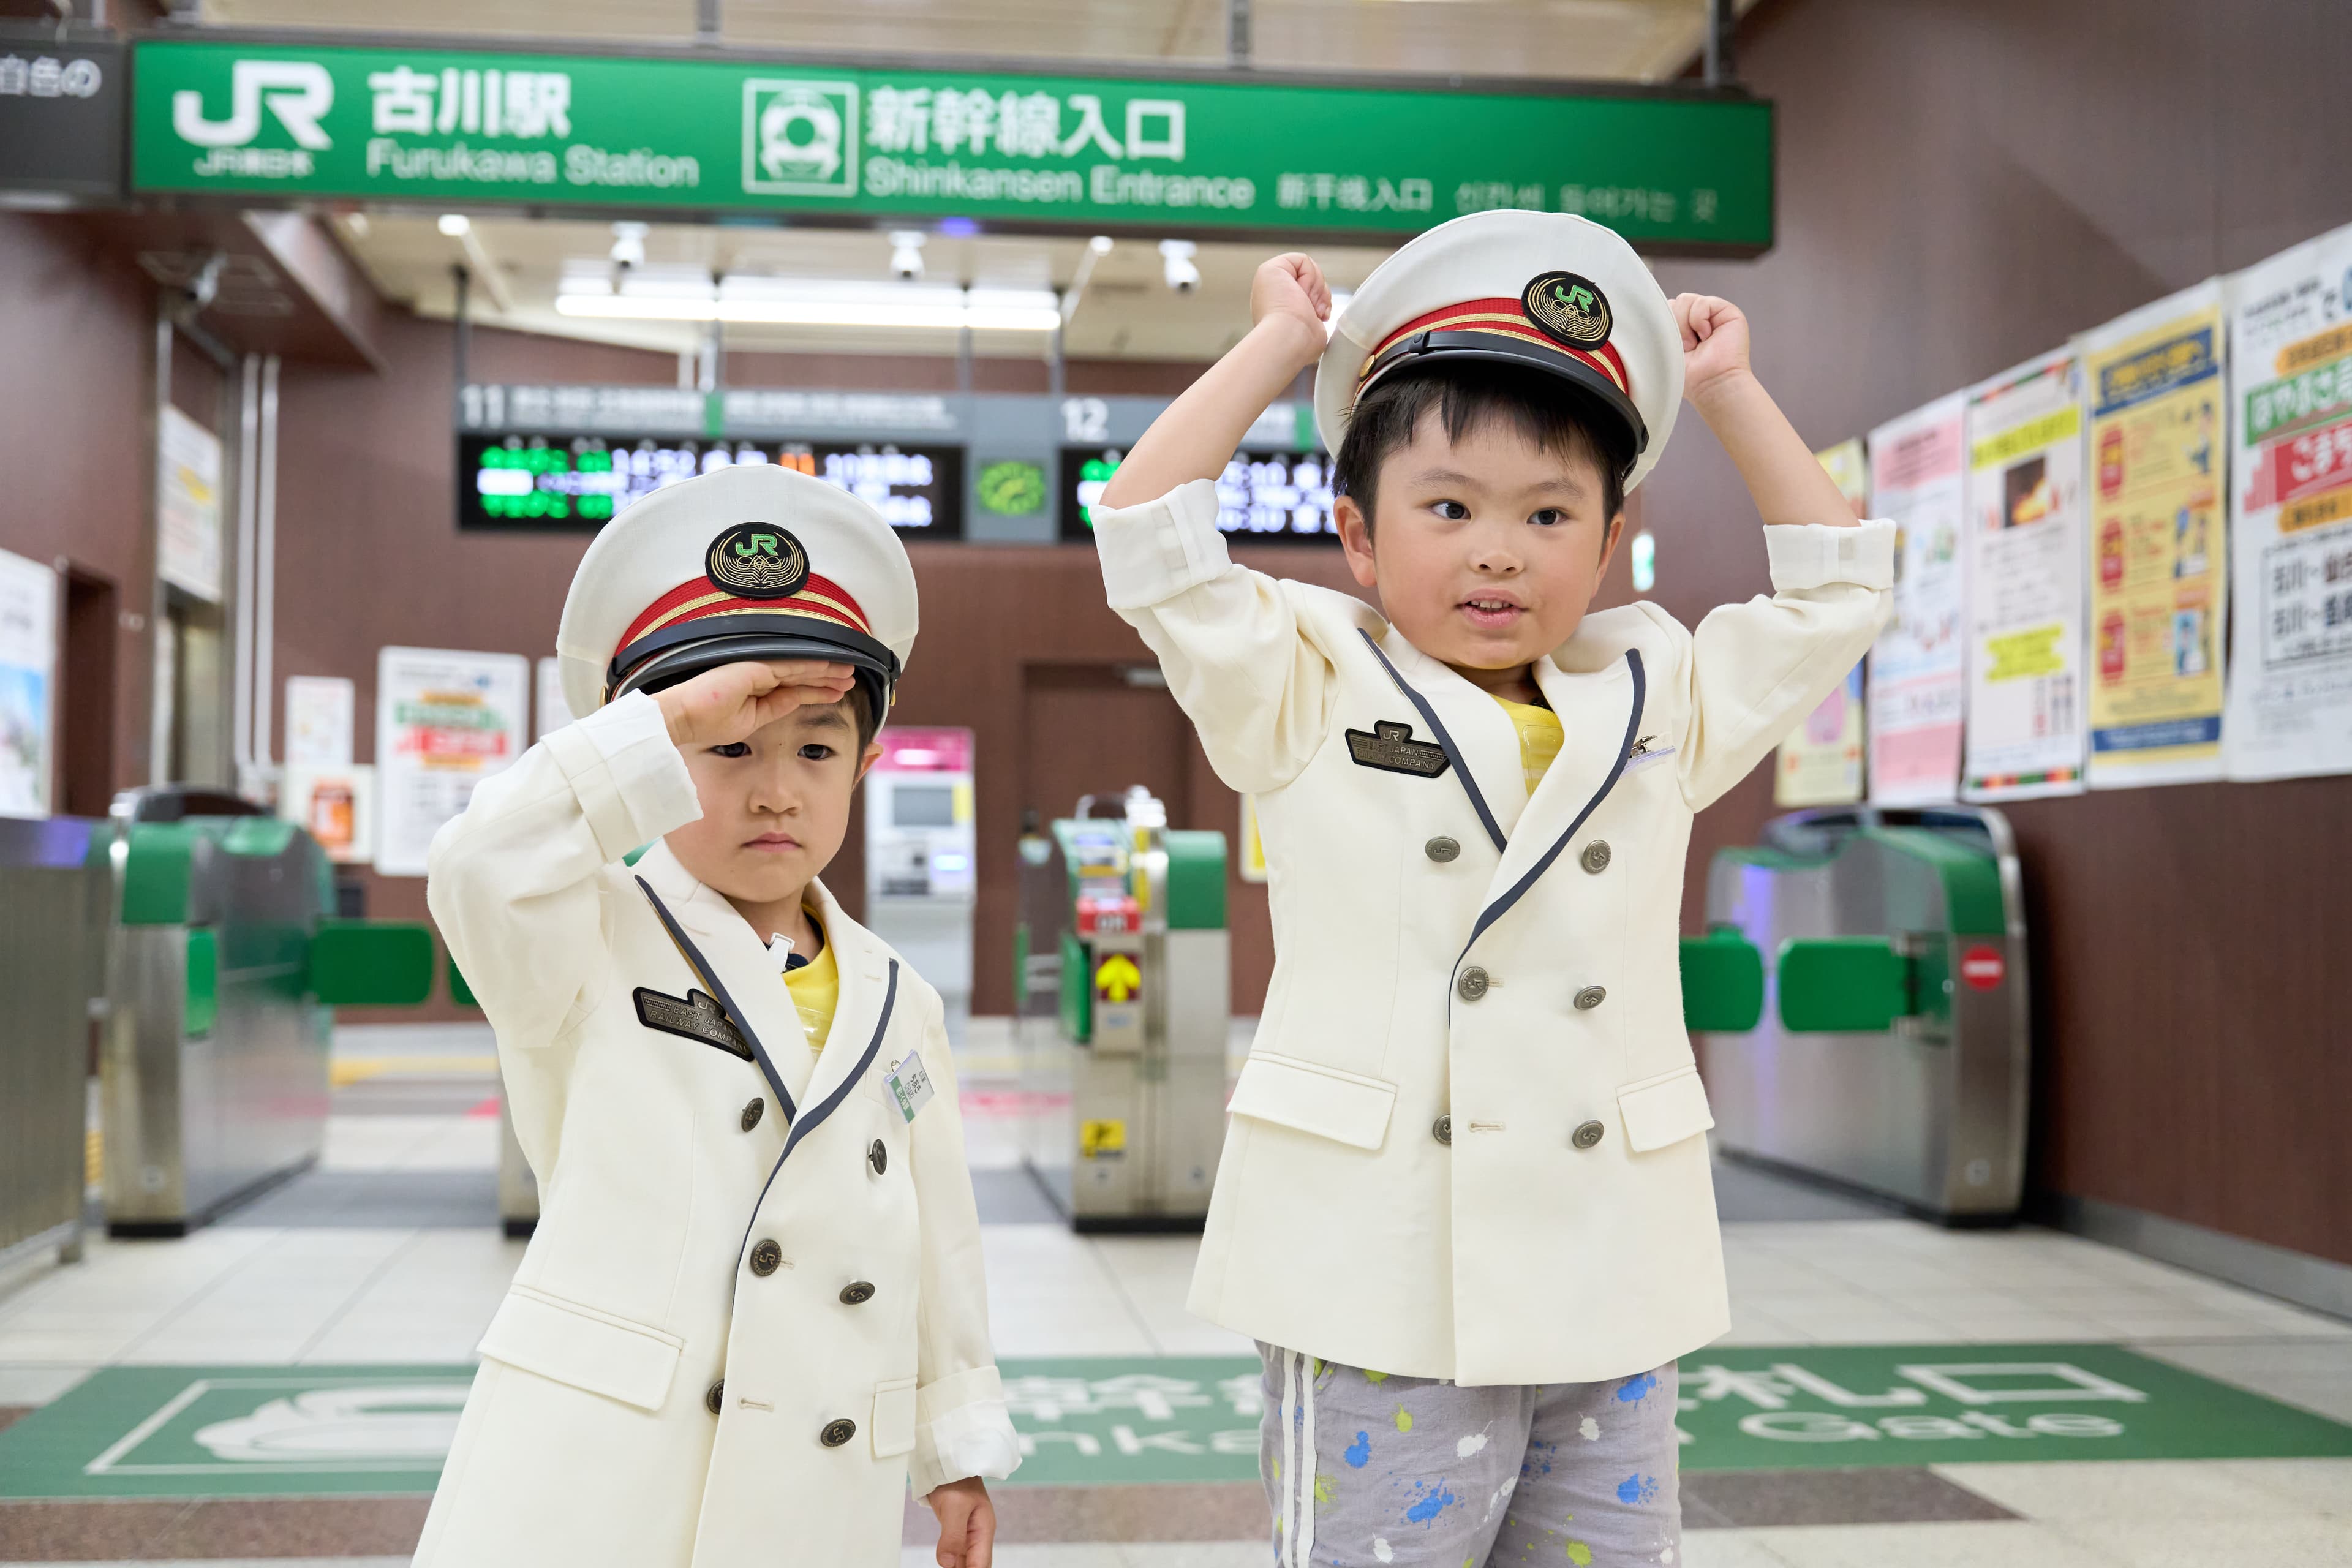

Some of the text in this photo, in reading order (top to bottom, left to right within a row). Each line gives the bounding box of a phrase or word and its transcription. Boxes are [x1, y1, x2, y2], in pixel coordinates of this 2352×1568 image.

[173, 59, 335, 151] JR
[368, 65, 571, 138] 古川駅
[865, 85, 1186, 161] 新幹線入口
[367, 138, 700, 187] Furukawa Station
[865, 156, 1256, 210] Shinkansen Entrance
[1555, 284, 1594, 313] JR
[461, 385, 506, 429] 11
[1061, 398, 1108, 442] 12
[736, 533, 778, 556] JR
[1383, 730, 1400, 742] JR
[1389, 744, 1419, 757] JAPAN
[1389, 756, 1437, 771] COMPANY
[673, 1005, 736, 1037] EAST JAPAN
[698, 1001, 717, 1014] JR
[649, 1010, 748, 1054] RAILWAY COMPANY
[1740, 1410, 2124, 1444] Gate
